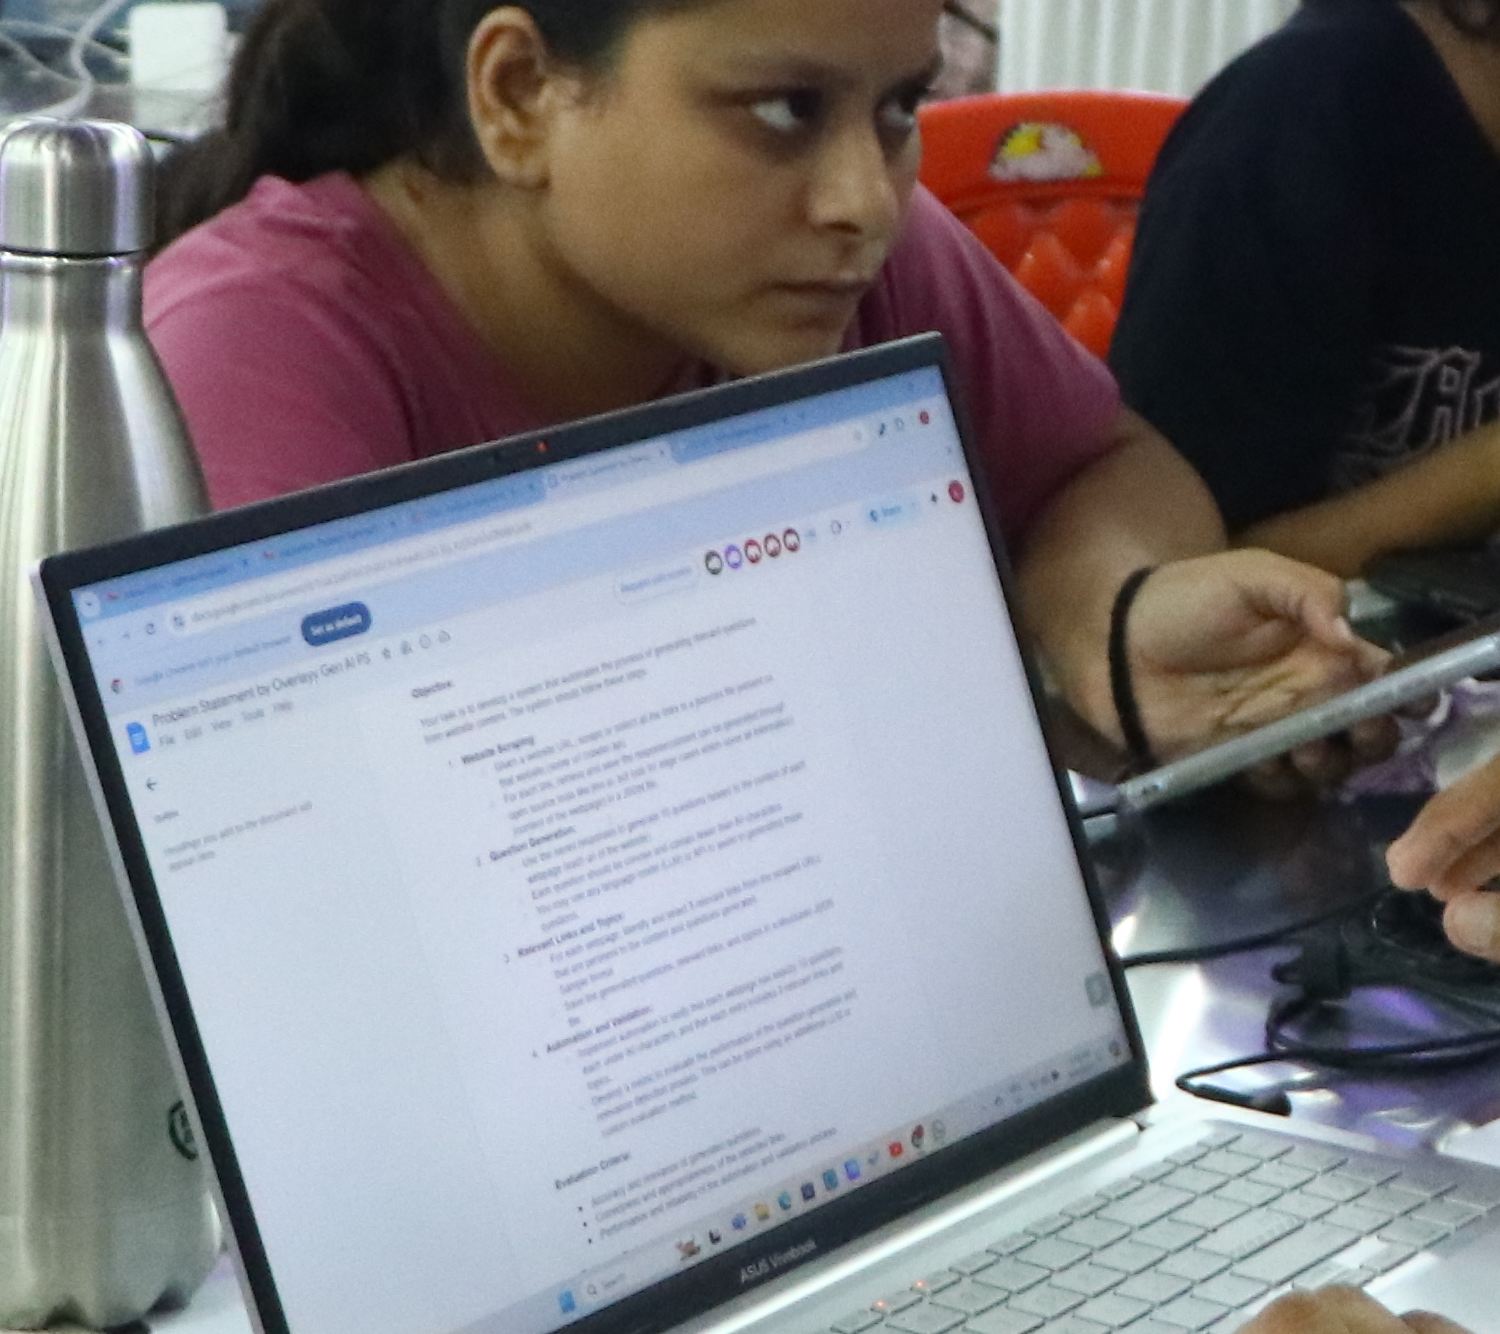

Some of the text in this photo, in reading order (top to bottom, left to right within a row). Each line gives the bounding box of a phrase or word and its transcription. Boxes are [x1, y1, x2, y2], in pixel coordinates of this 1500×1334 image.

[150, 701, 200, 731] Problem
[198, 685, 257, 717] Statement
[254, 680, 272, 700] by
[318, 659, 345, 681] Gen
